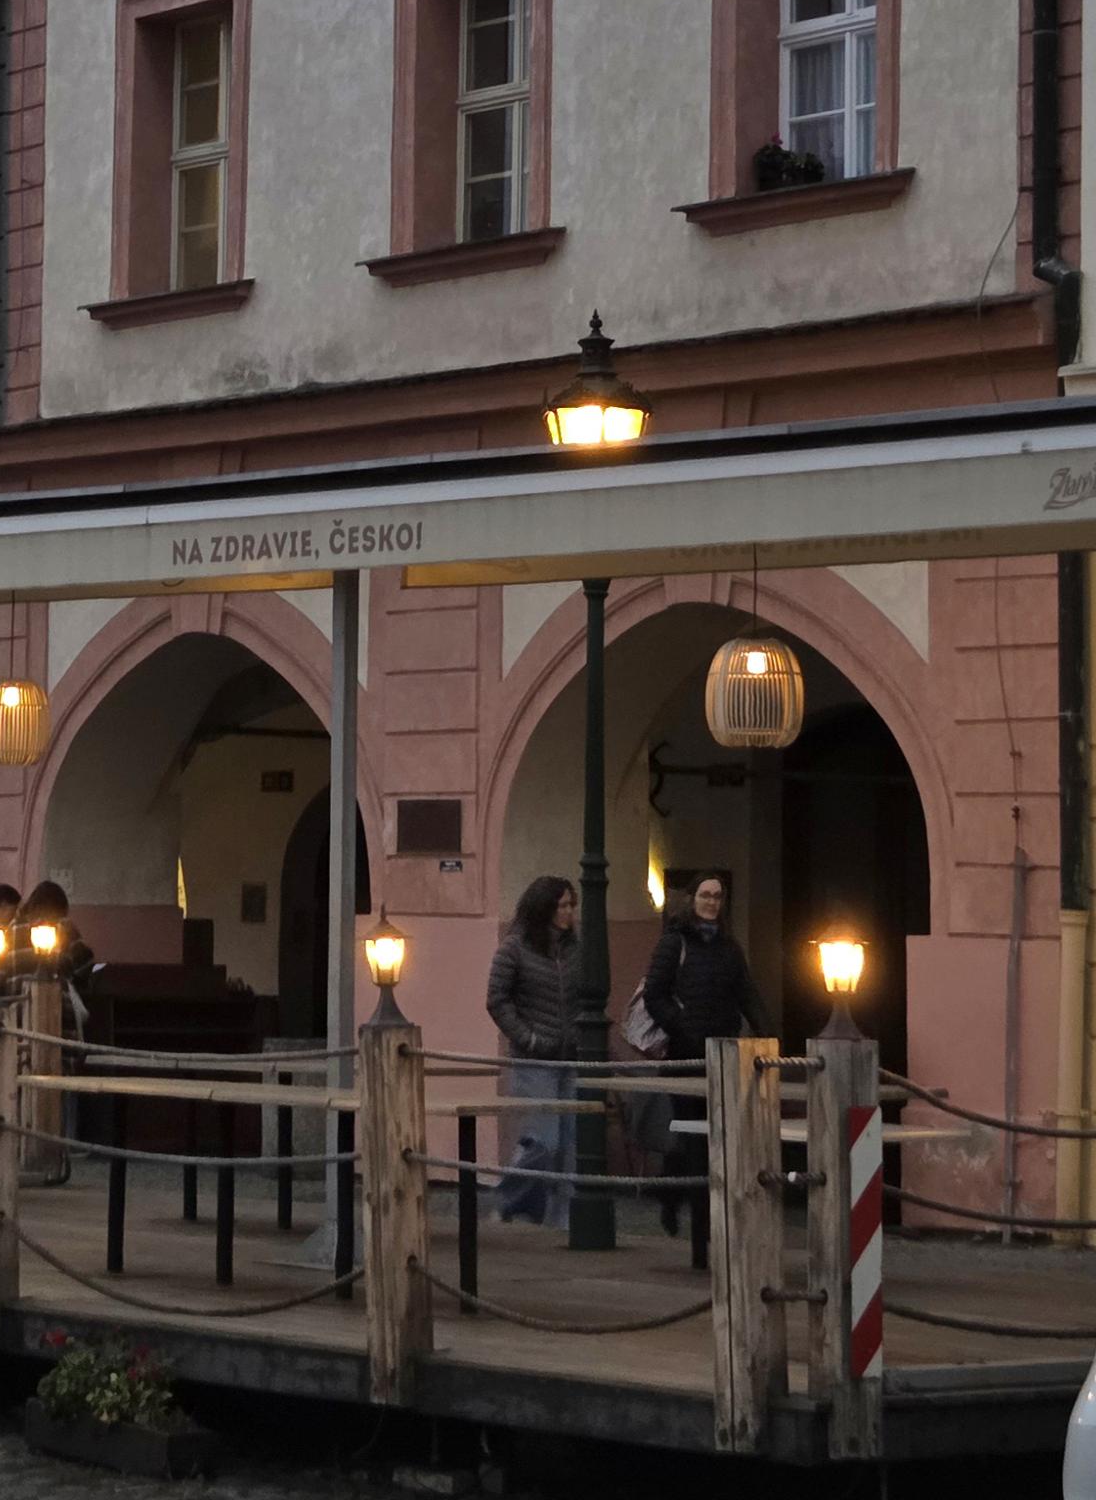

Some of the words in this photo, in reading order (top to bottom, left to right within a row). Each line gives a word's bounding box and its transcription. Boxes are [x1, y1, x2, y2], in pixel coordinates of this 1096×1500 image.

[172, 537, 204, 566] NA
[210, 530, 320, 563] ZDRAVIE,
[329, 519, 423, 555] ČESKO!
